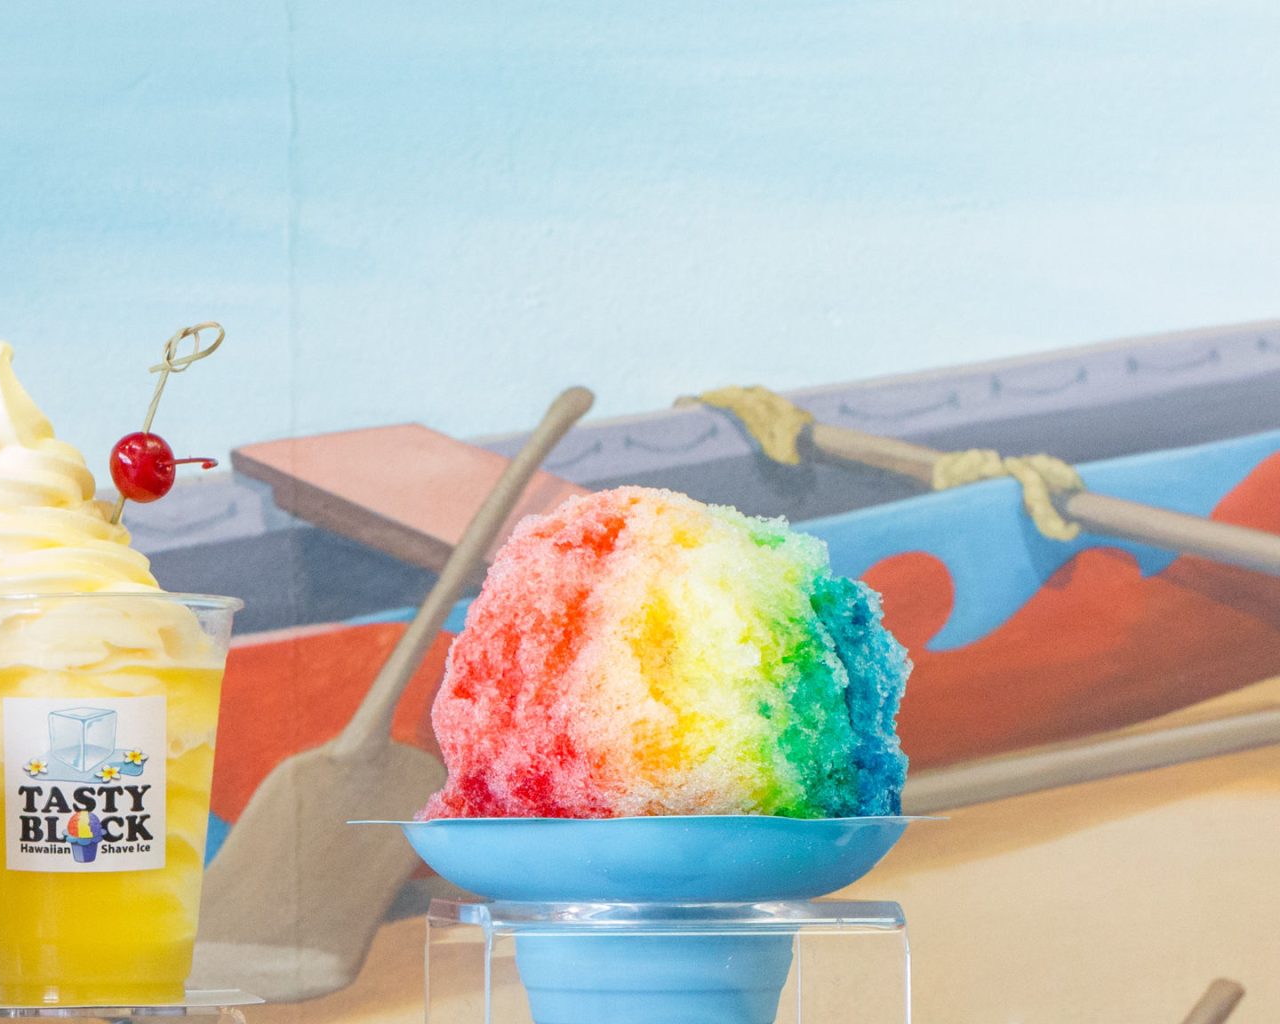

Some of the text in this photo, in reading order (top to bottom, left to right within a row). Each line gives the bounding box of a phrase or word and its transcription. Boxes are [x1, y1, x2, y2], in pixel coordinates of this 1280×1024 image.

[18, 784, 152, 814] TASTY
[19, 814, 154, 844] BLCK
[20, 842, 151, 855] Hawaiian Shave Ice
